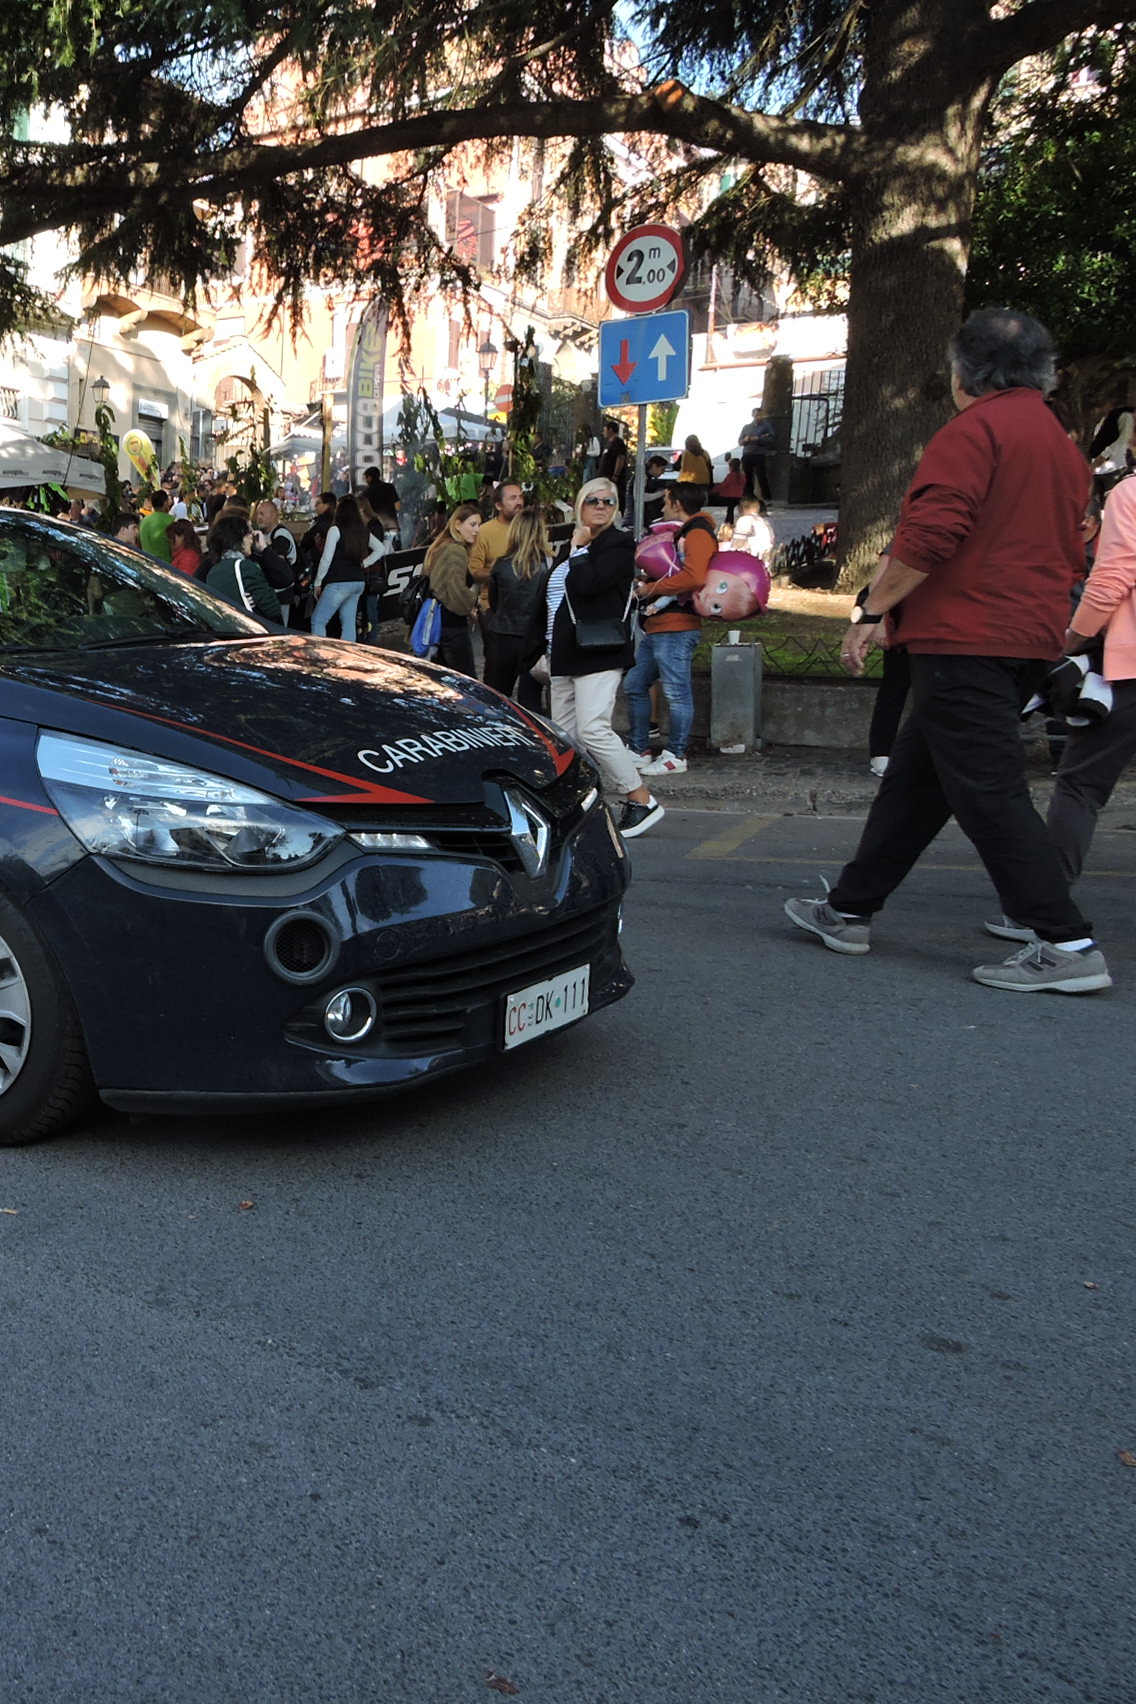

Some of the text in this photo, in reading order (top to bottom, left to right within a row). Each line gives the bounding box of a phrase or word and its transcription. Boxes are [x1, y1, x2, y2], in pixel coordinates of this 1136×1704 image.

[357, 727, 535, 773] CARABINIERI
[535, 990, 555, 1025] DK
[564, 977, 585, 1013] 111
